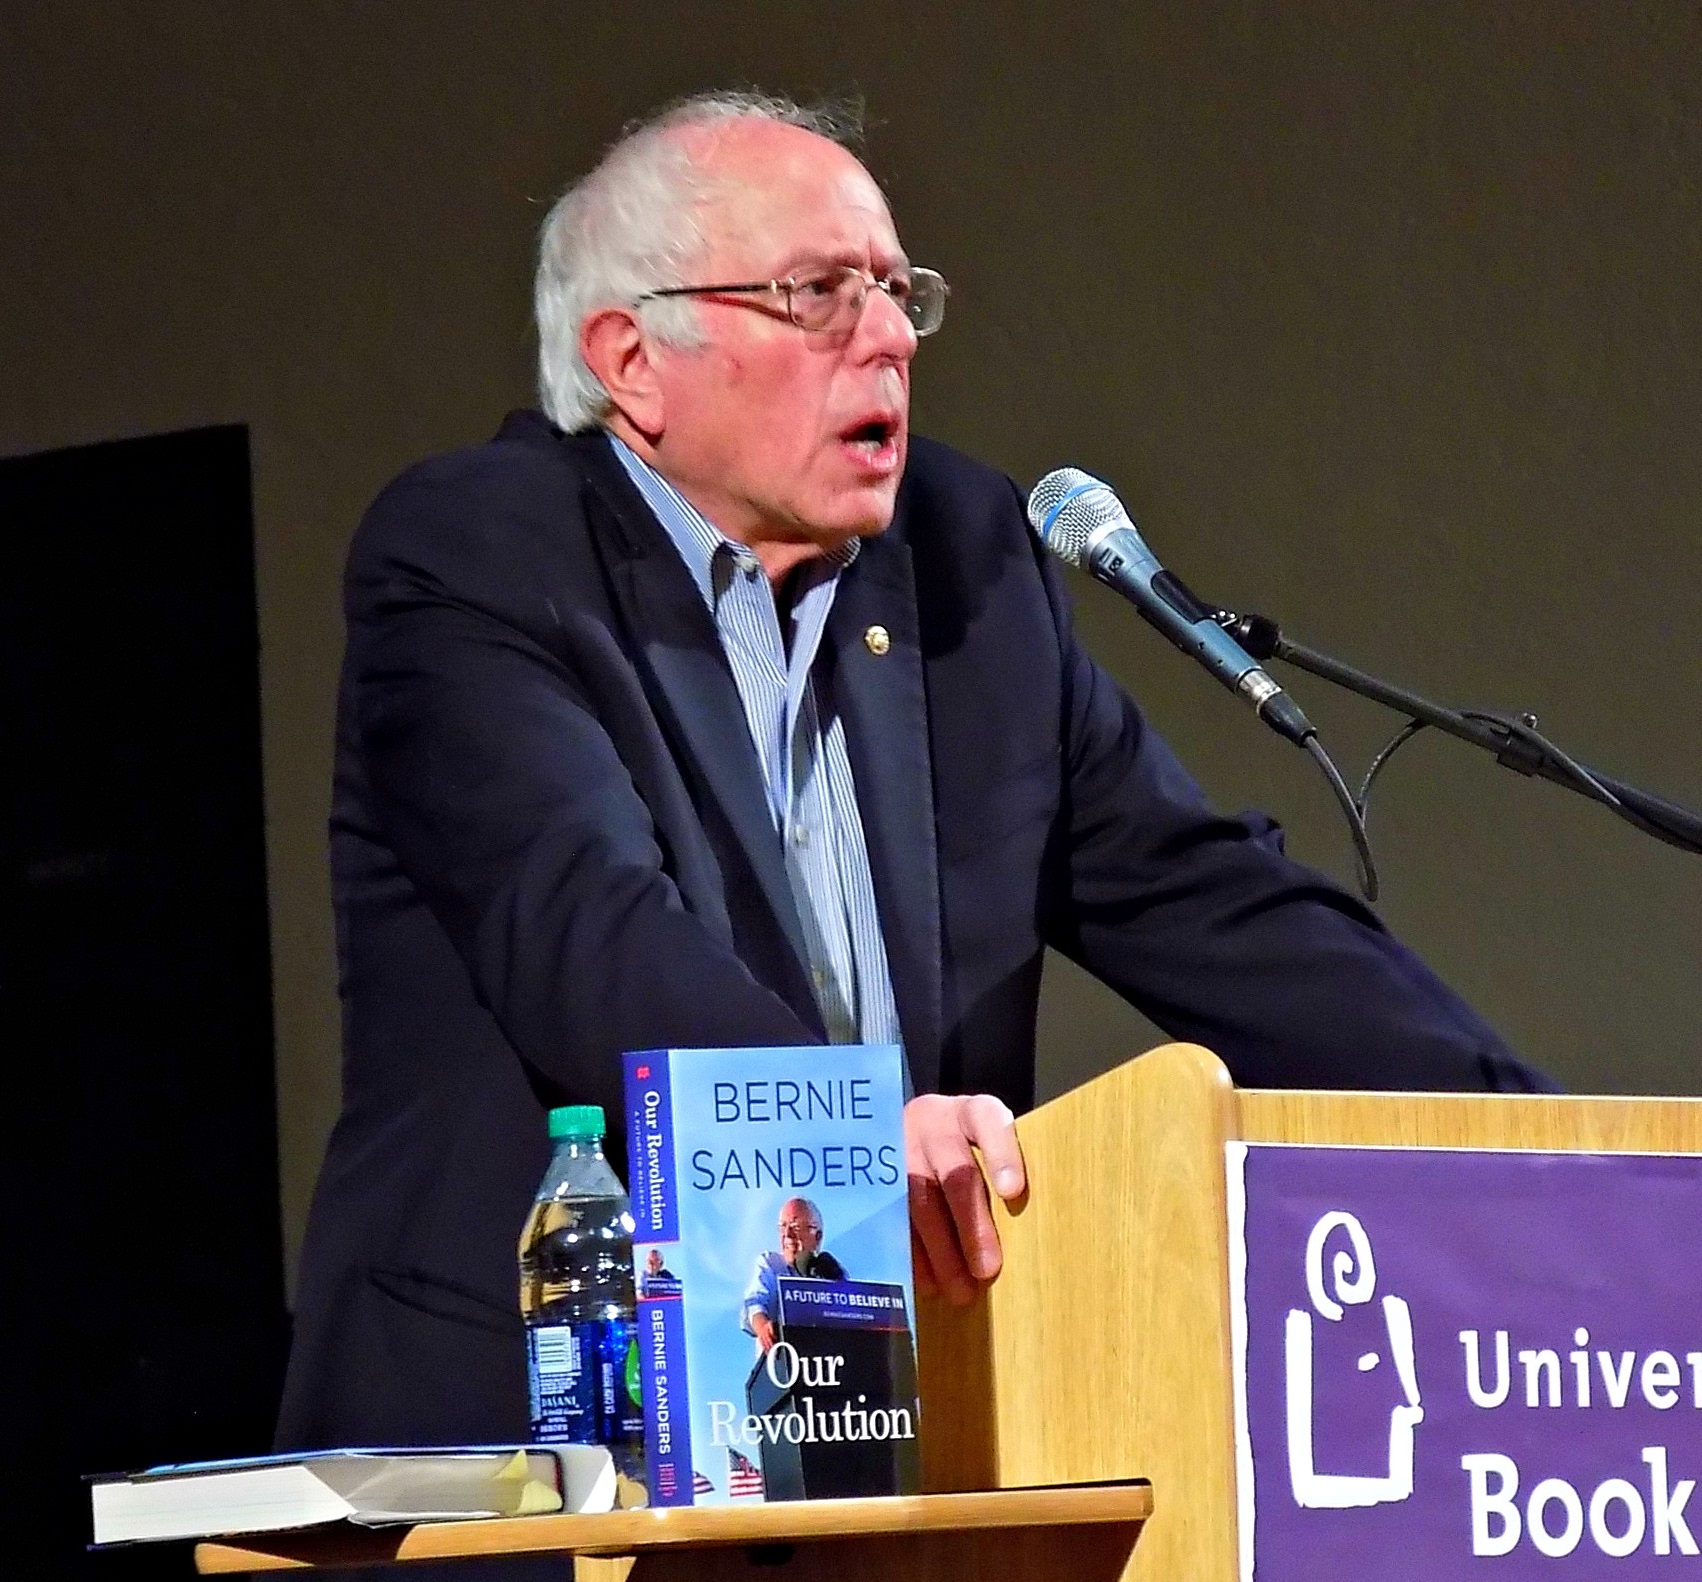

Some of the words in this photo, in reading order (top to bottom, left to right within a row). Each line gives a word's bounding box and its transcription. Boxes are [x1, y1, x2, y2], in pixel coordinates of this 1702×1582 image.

[644, 1091, 661, 1129] Our
[714, 1079, 873, 1123] BERNIE
[647, 1134, 665, 1231] Revolution
[692, 1145, 899, 1191] SANDERS
[784, 1289, 793, 1300] A
[793, 1290, 833, 1304] FUTURE
[833, 1292, 848, 1305] TO
[848, 1294, 890, 1308] BELIEVE
[892, 1298, 904, 1309] IN
[651, 1309, 667, 1371] BERNIE
[766, 1341, 845, 1389] Our
[655, 1375, 671, 1455] SANDERS
[707, 1394, 915, 1447] Revolution
[1461, 1446, 1701, 1558] Book
